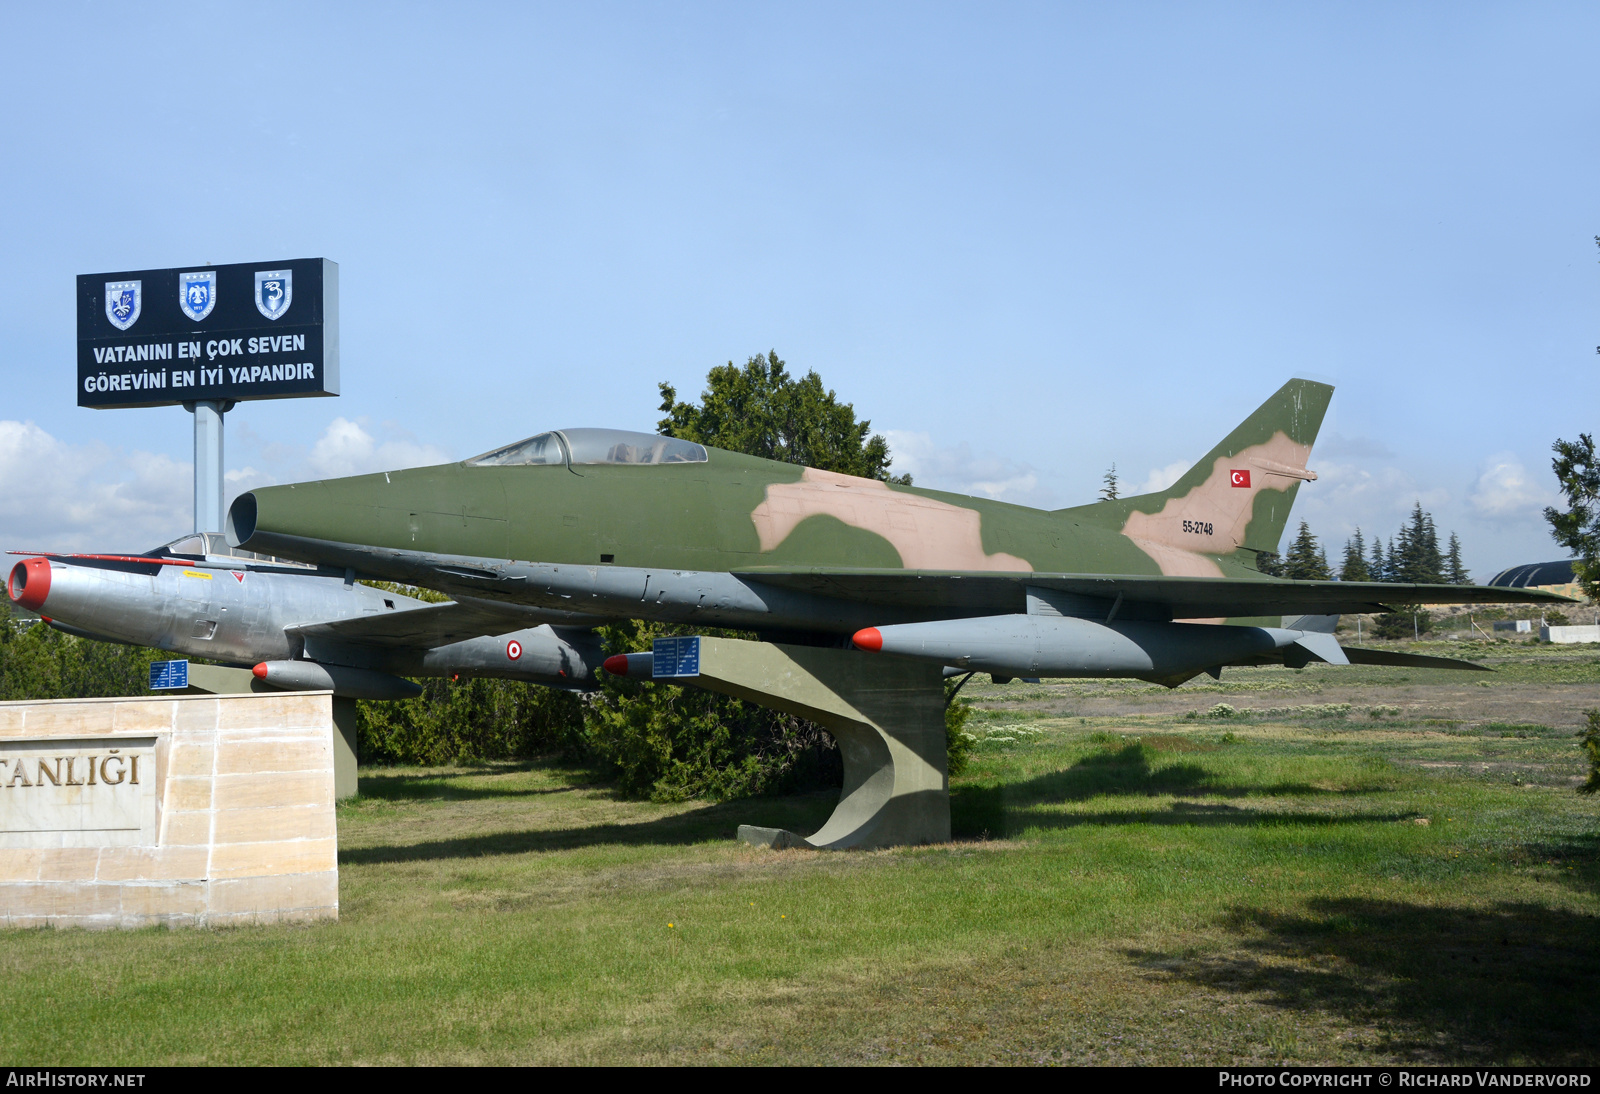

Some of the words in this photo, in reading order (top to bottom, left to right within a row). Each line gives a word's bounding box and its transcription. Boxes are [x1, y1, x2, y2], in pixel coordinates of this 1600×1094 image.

[93, 343, 172, 364] VATANINI
[178, 341, 201, 359] EN
[206, 338, 243, 361] ÇOK
[247, 334, 305, 354] SEVEN
[84, 367, 166, 393] GÖREVİNİ
[172, 370, 195, 388] EN
[200, 365, 223, 386] İYİ
[228, 362, 315, 384] YAPANDIR
[1182, 520, 1212, 535] 55-2748
